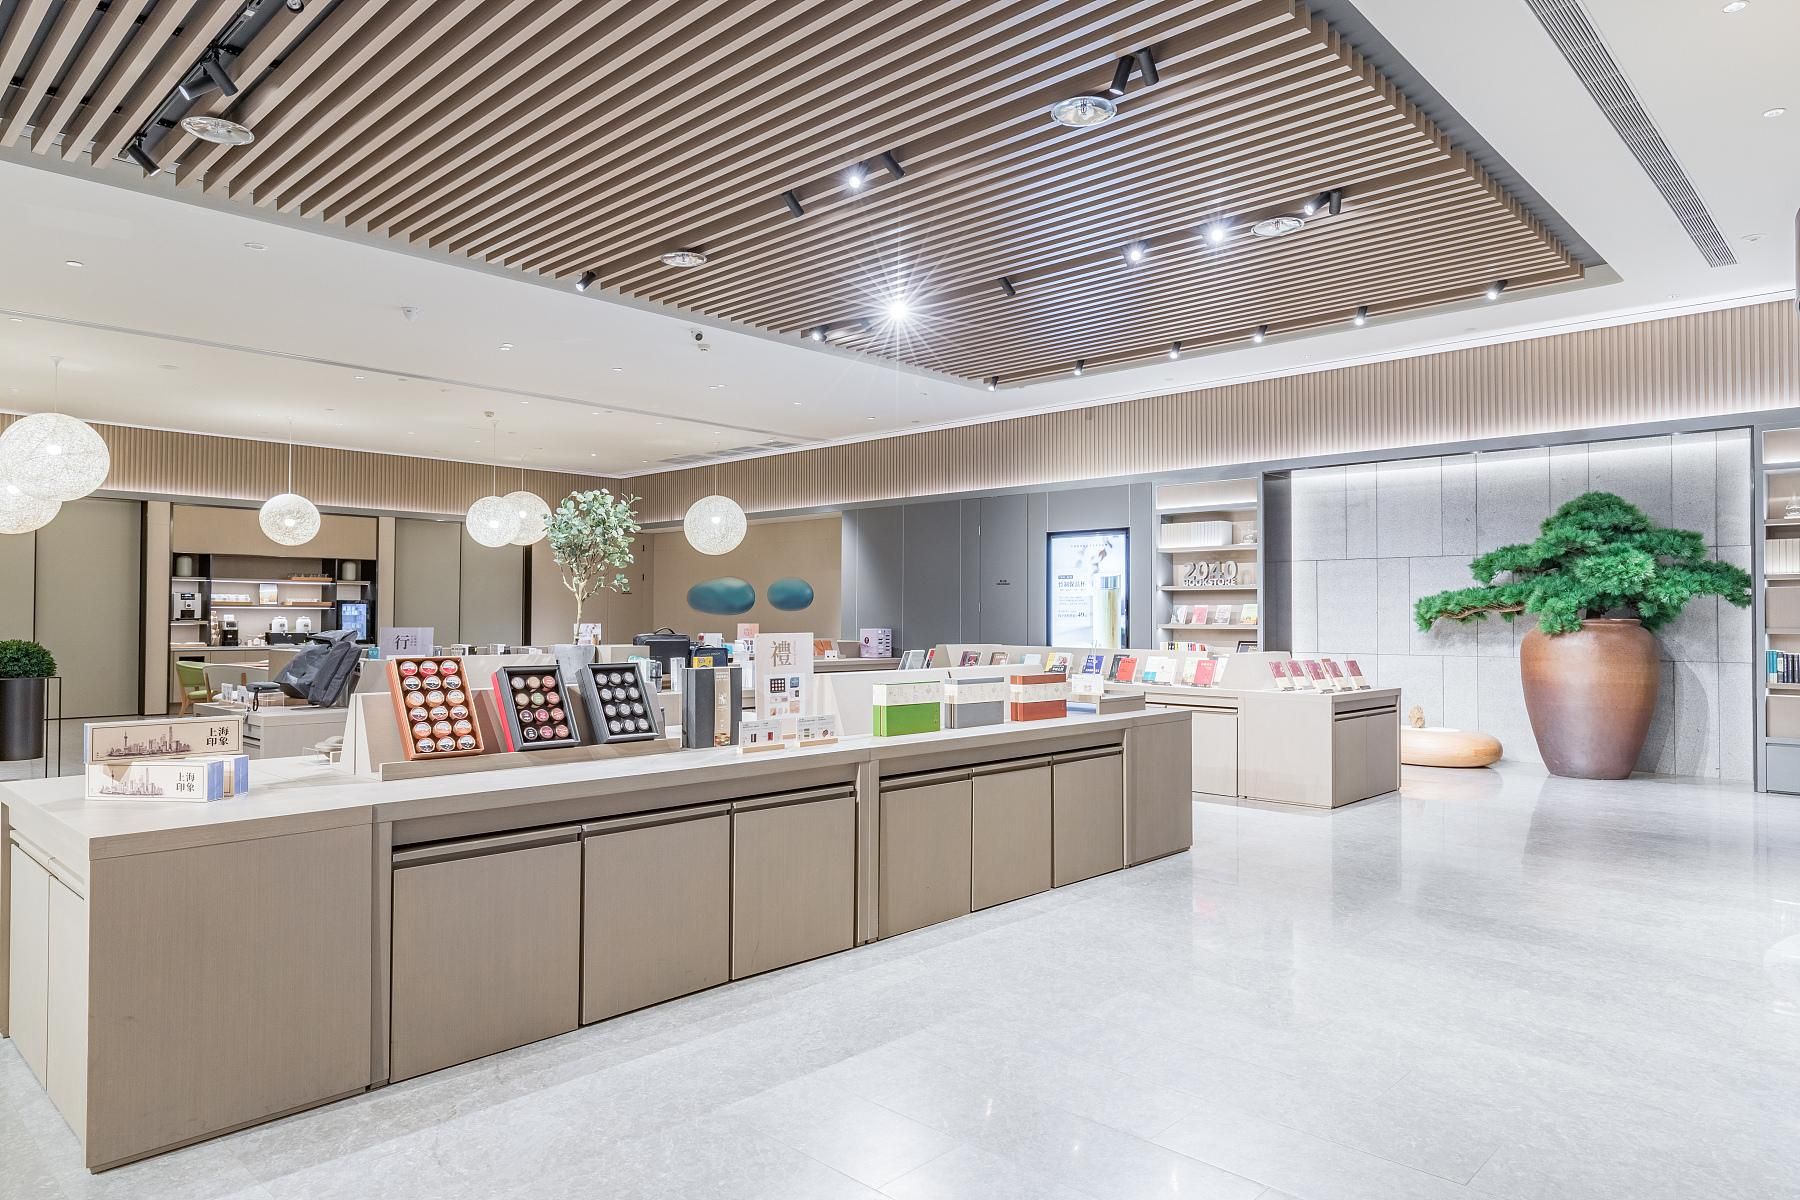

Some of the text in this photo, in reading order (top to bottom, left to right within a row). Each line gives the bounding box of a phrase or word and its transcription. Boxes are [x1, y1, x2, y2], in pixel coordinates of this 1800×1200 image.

[1184, 560, 1238, 579] 2040
[1184, 578, 1237, 587] BOOKSTORE
[395, 635, 409, 650] 行
[771, 640, 792, 667] 禮
[209, 726, 230, 737] 上海
[206, 737, 229, 747] 印象
[179, 771, 195, 782] 上海
[176, 782, 195, 793] 印象
